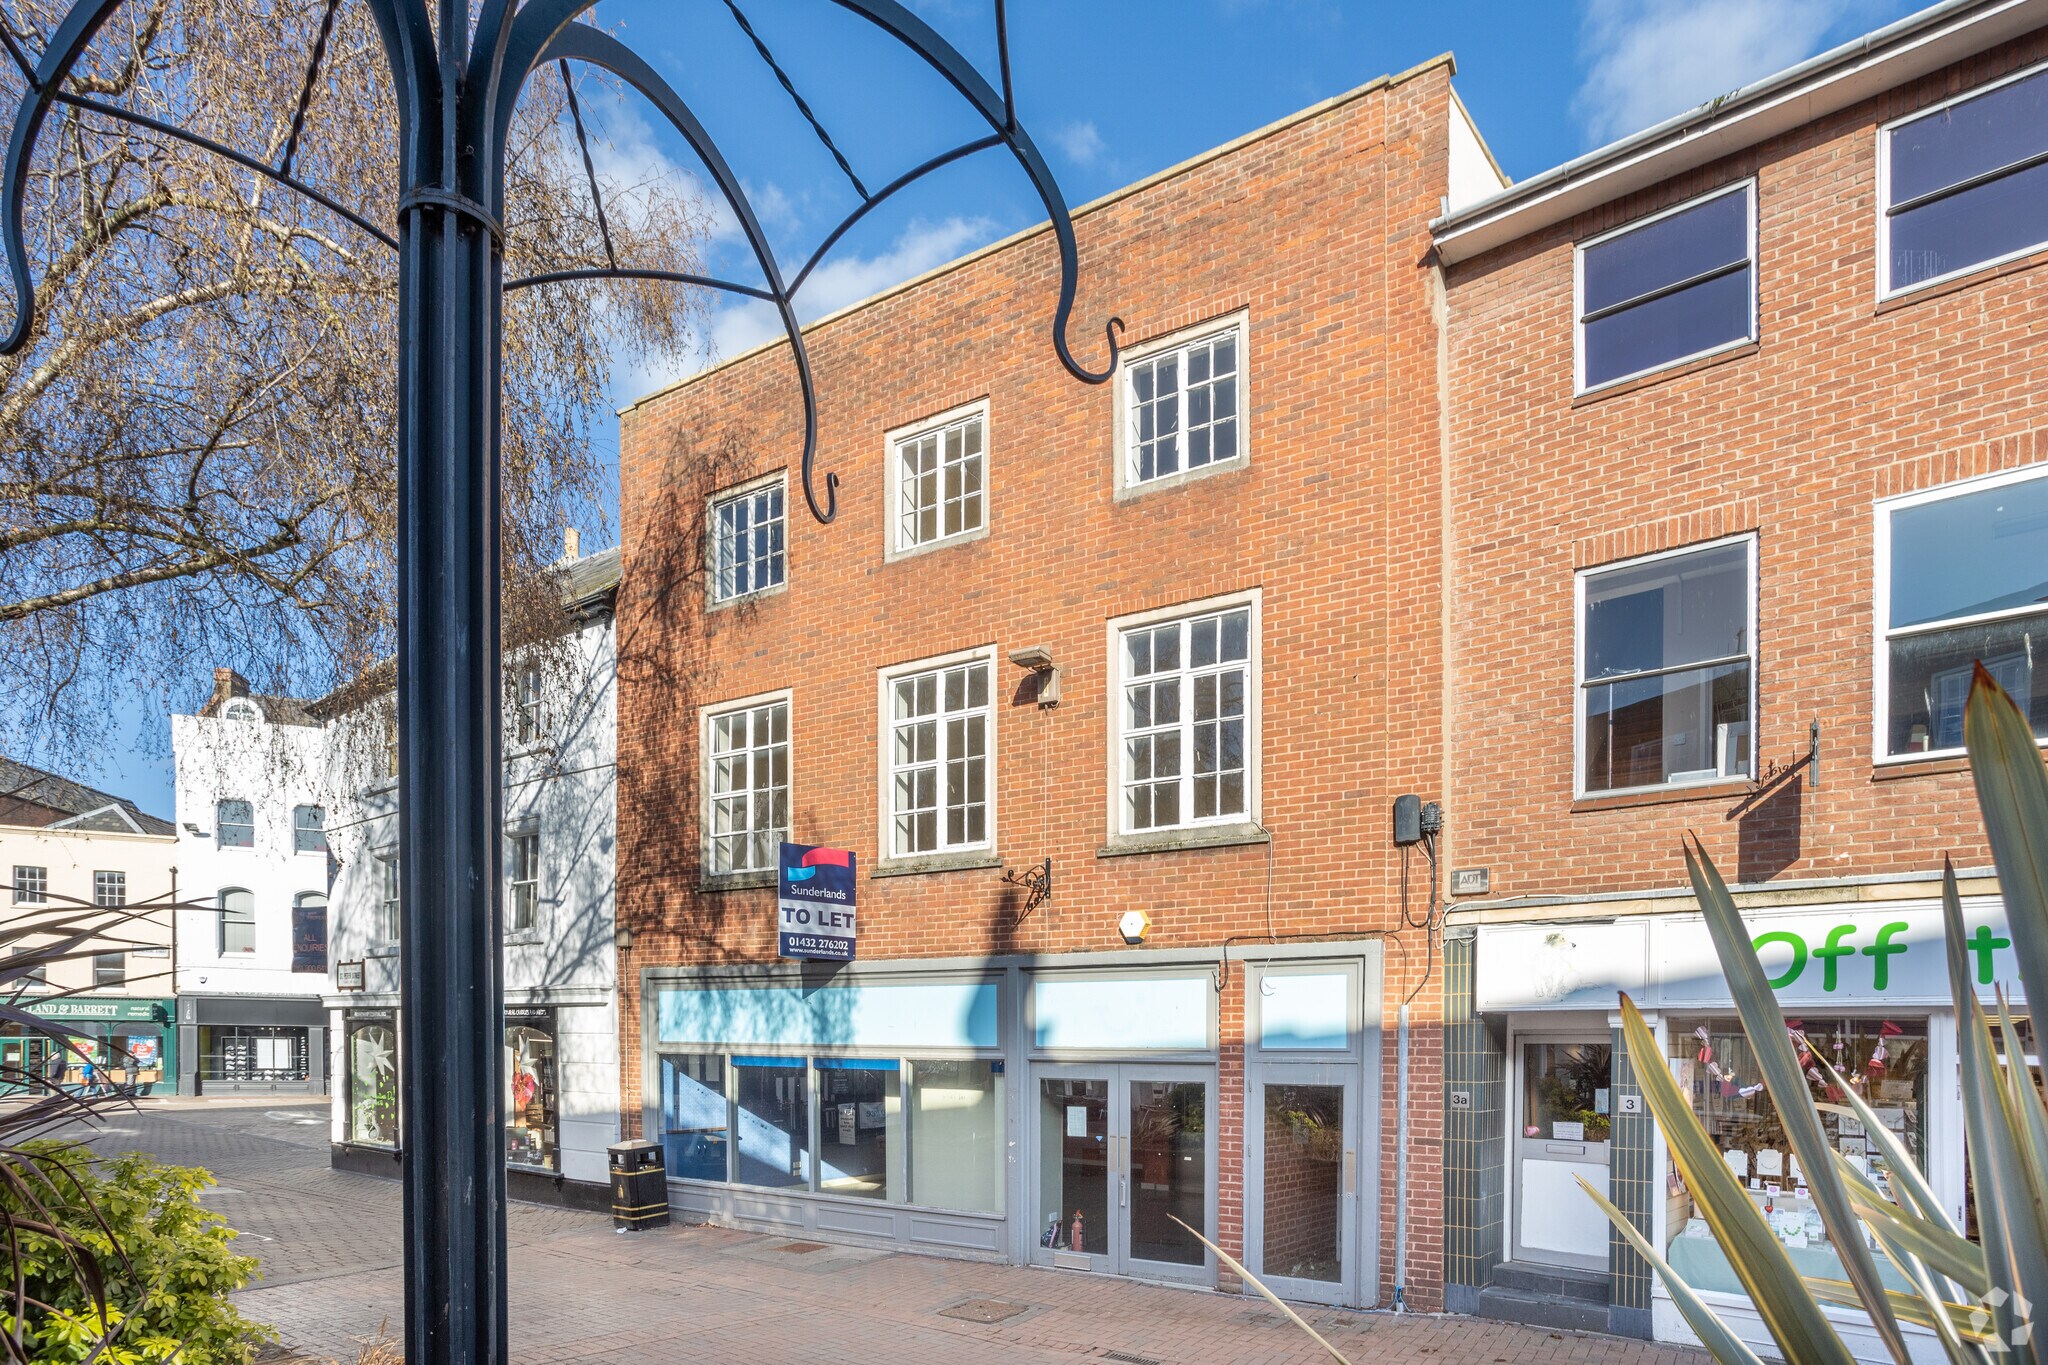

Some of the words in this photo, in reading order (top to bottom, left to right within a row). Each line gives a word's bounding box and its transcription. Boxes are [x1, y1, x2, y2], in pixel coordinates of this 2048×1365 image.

[1460, 873, 1481, 886] ADT
[791, 884, 846, 899] Sunderlands
[782, 908, 811, 924] TO
[818, 911, 854, 928] LET
[789, 937, 816, 947] 01432
[818, 939, 849, 950] 276202
[789, 948, 848, 956] www.sunderlands.co.uk
[1751, 921, 1909, 993] Off
[71, 1004, 119, 1016] BARRETT
[1453, 1094, 1468, 1105] 3a
[1625, 1099, 1635, 1110] 3
